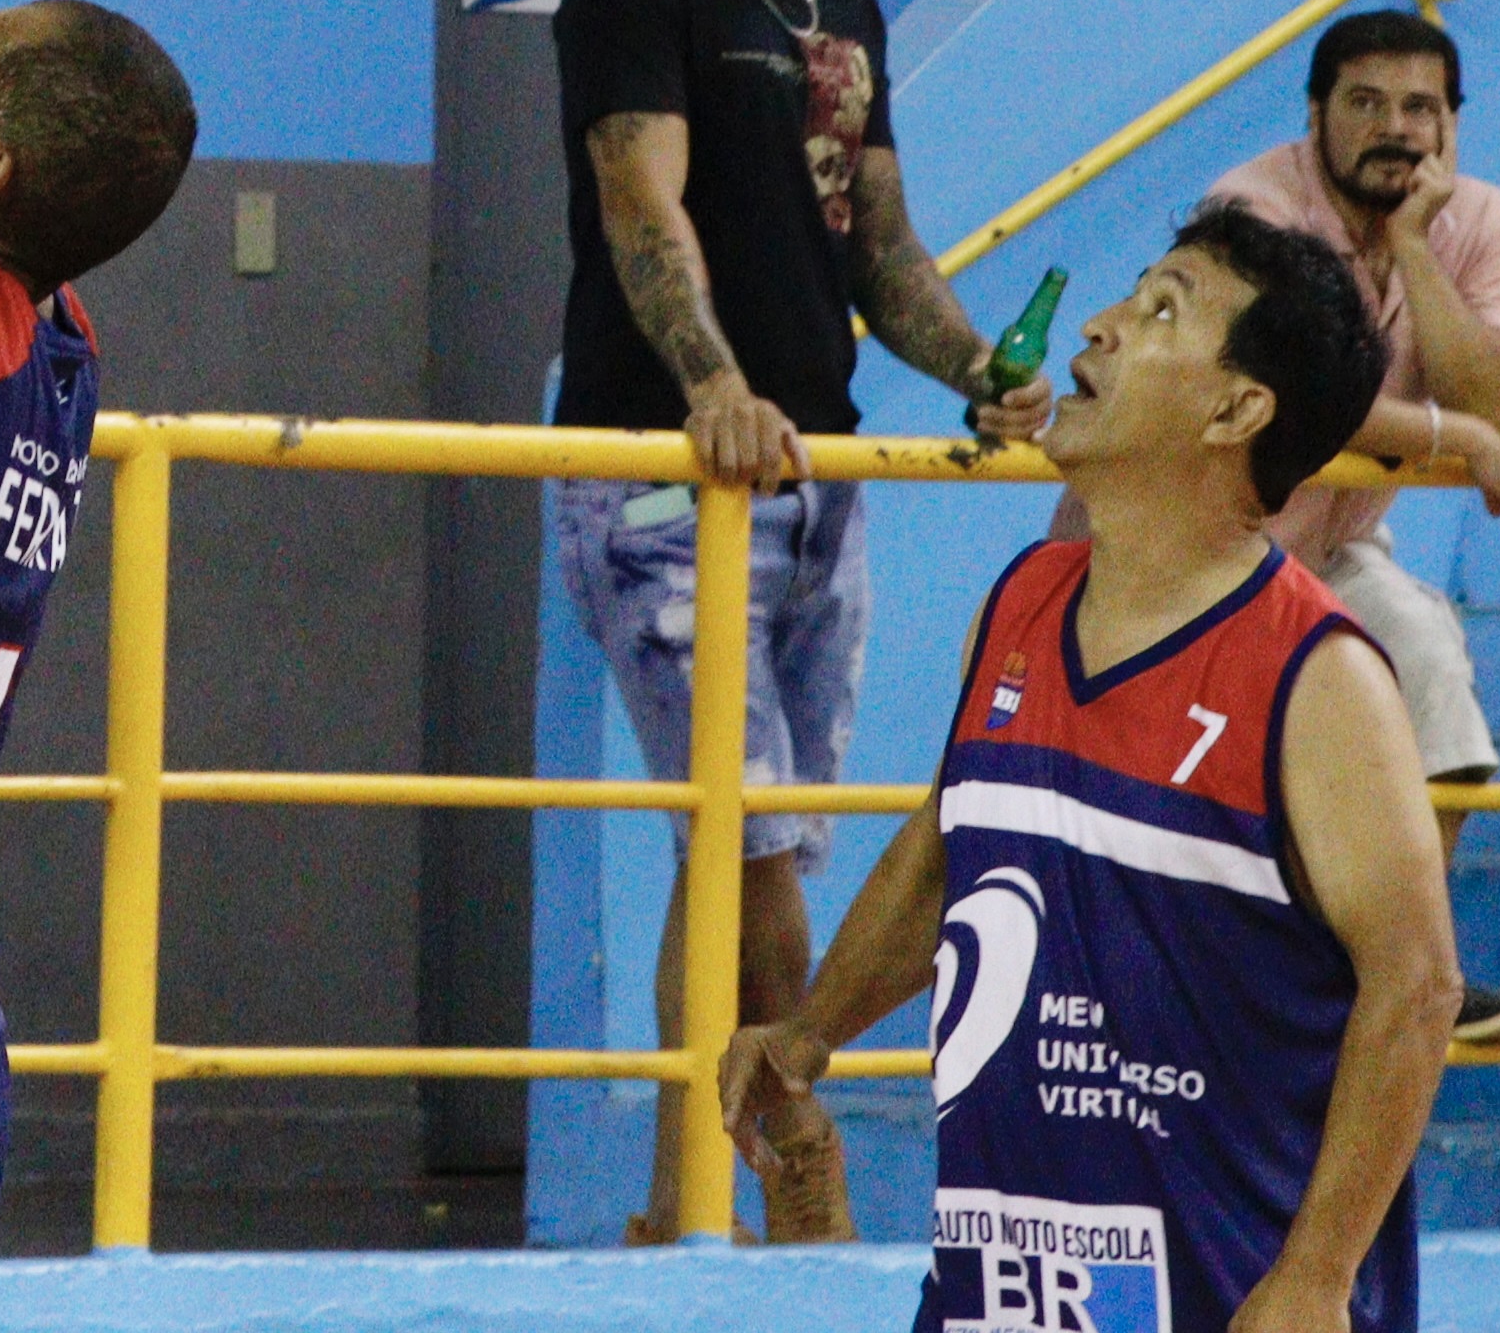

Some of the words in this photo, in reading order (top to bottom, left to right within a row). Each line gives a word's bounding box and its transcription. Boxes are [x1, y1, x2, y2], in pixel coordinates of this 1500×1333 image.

[1170, 703, 1228, 785] 7
[934, 1209, 993, 1245] AUTO
[1063, 1223, 1156, 1262] ESCOLA
[981, 1246, 1102, 1333] BR
